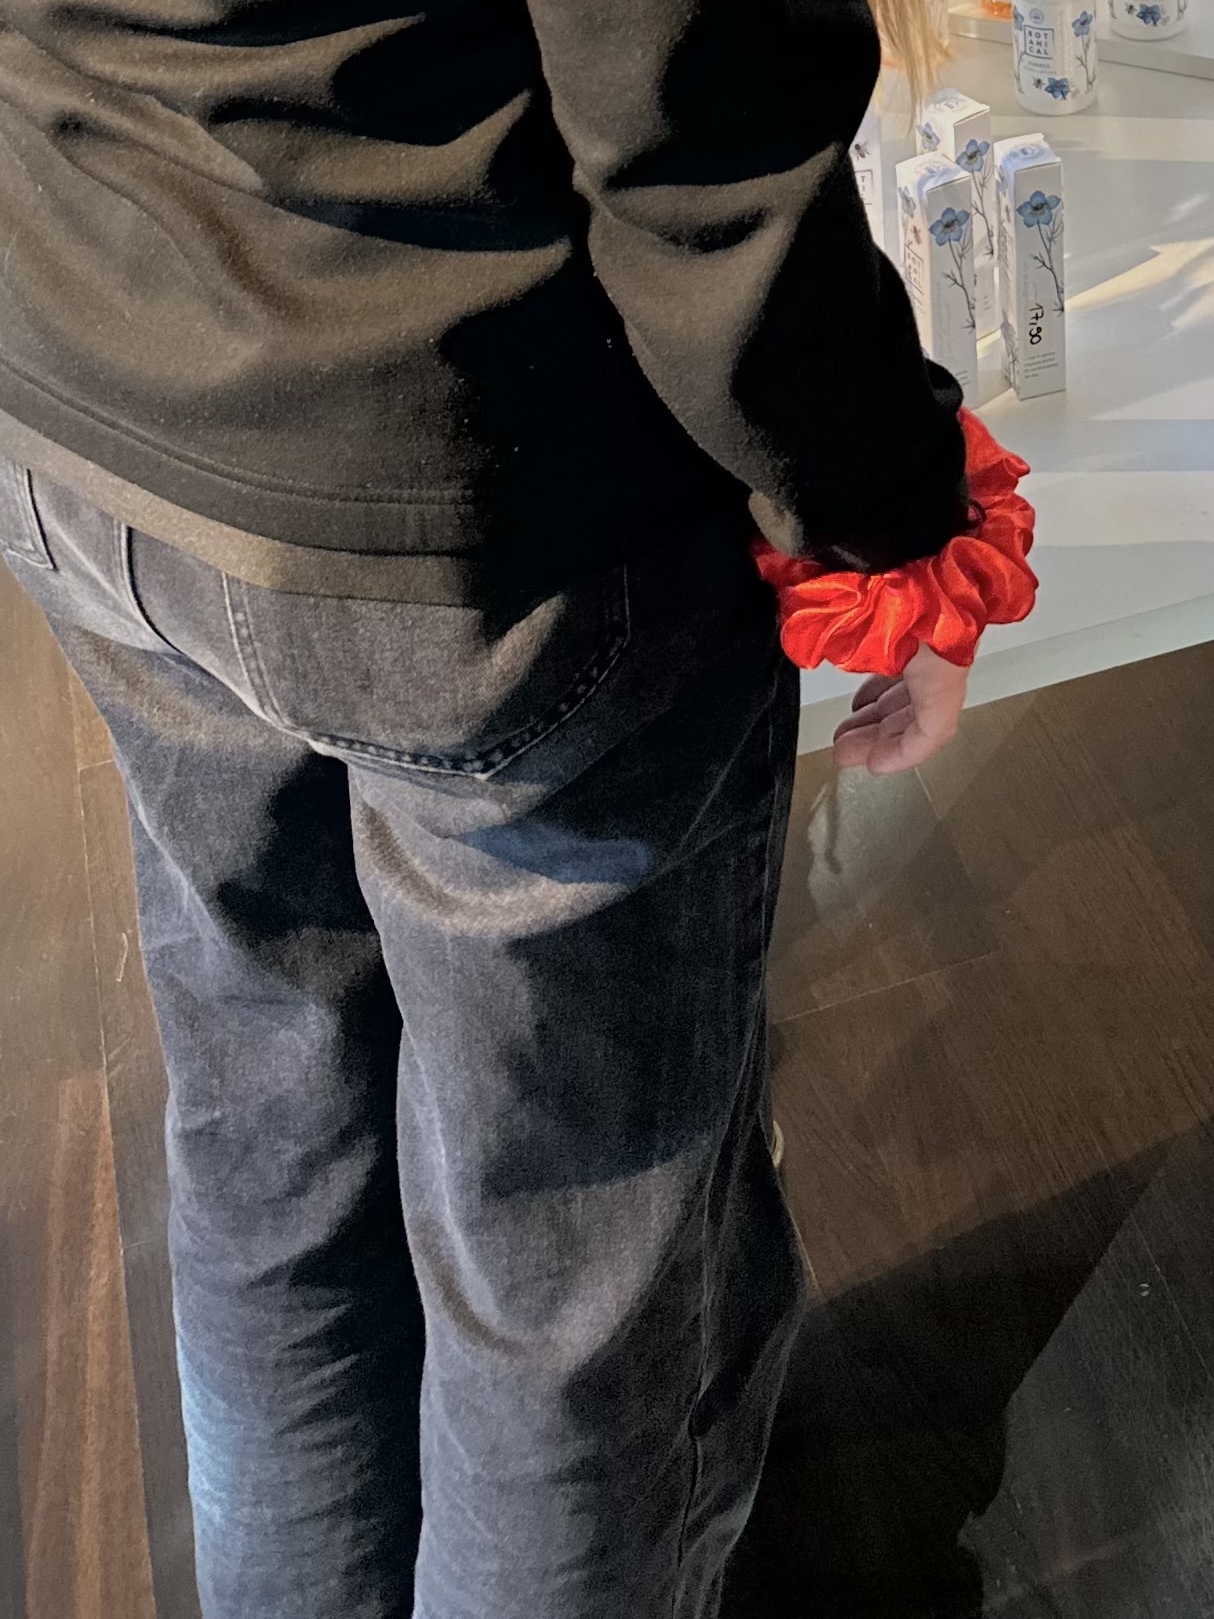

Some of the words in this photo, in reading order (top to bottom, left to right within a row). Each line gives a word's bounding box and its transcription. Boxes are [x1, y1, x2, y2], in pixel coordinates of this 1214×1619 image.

[1028, 30, 1049, 40] BOT
[1028, 39, 1048, 48] ANI
[1028, 45, 1049, 56] CAL
[1028, 302, 1045, 346] 17,90
